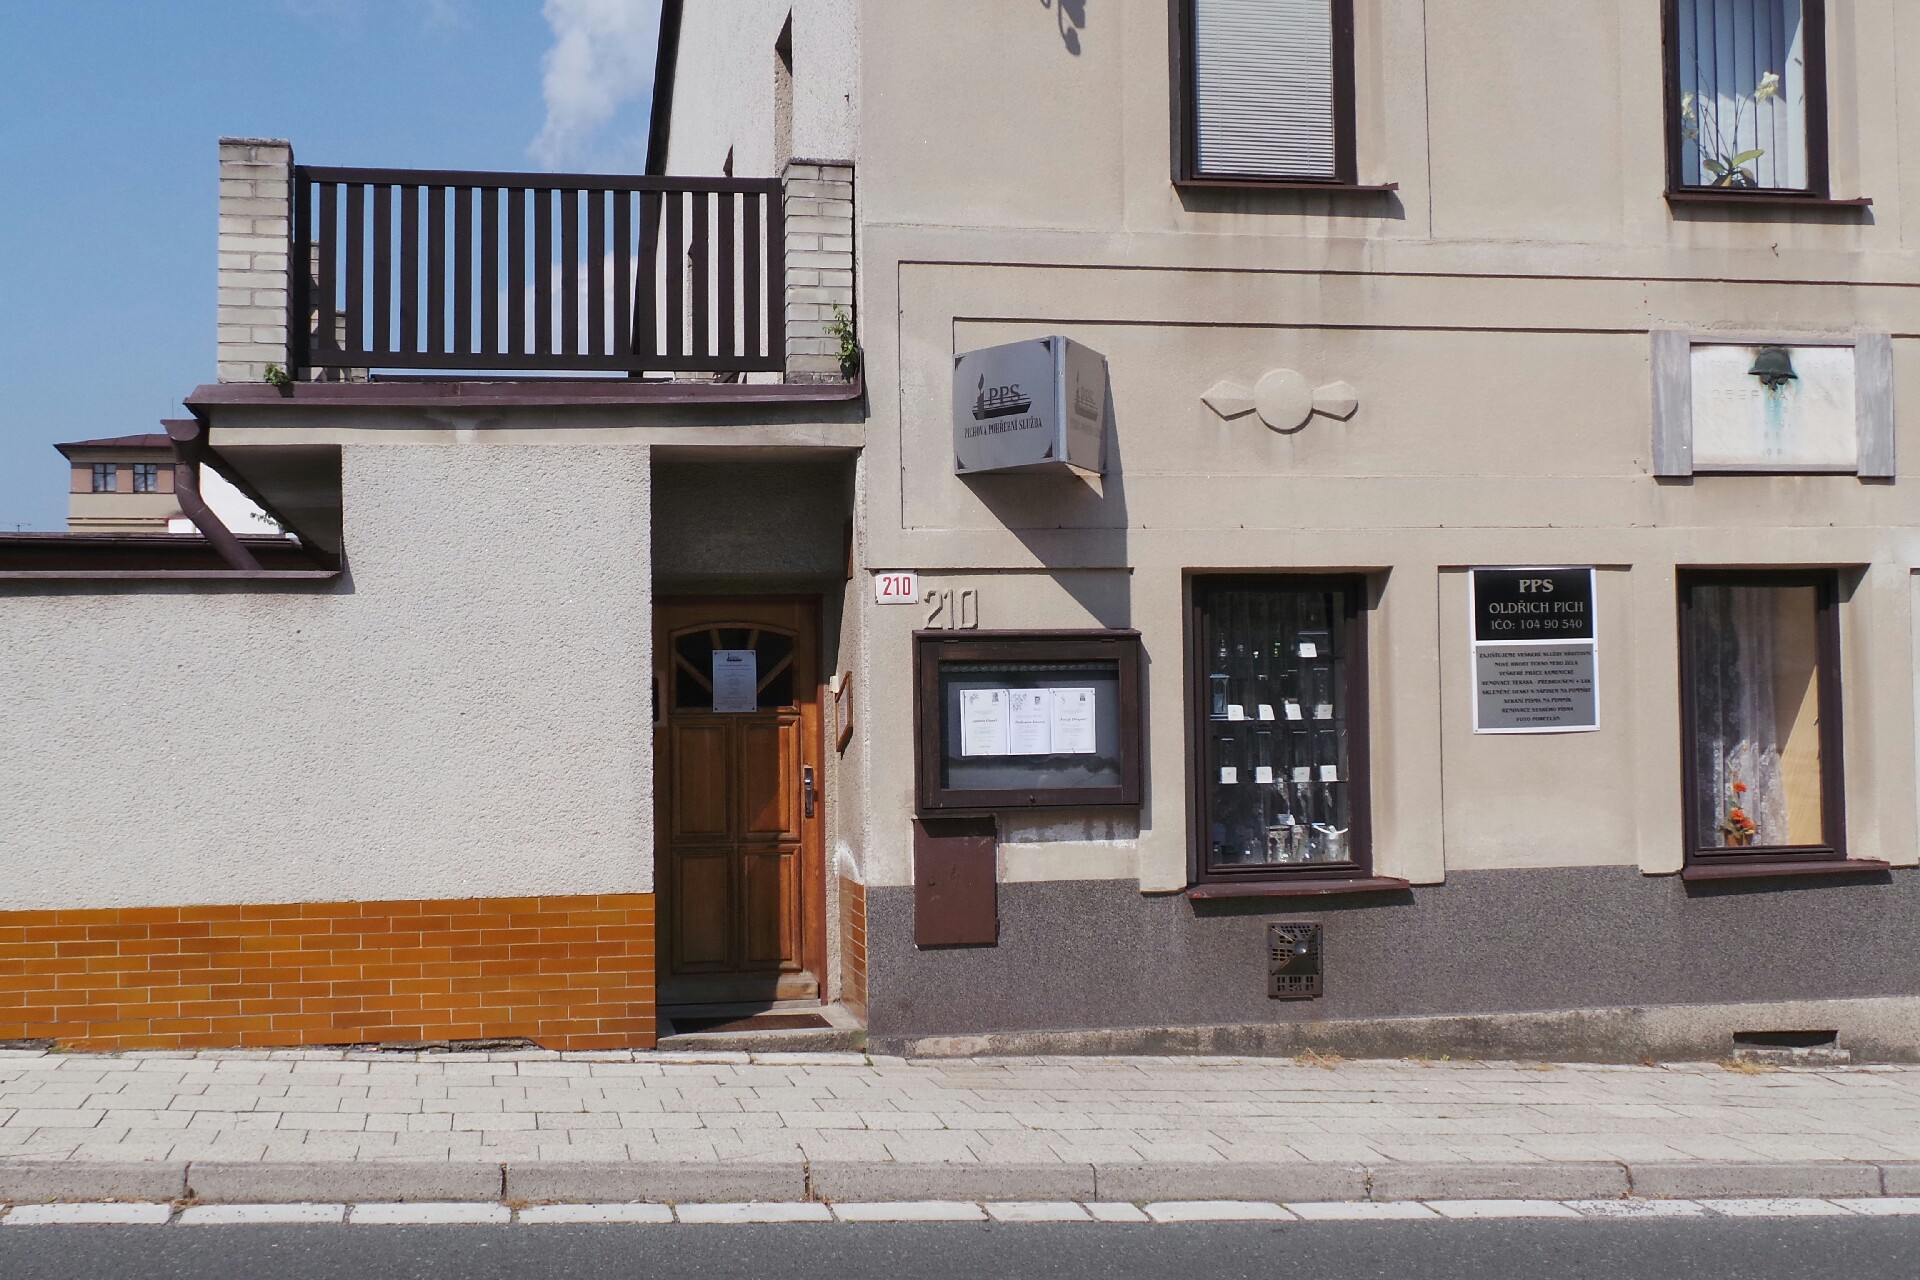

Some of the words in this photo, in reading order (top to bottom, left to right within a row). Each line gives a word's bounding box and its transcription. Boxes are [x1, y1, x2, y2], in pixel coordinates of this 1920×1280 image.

[989, 384, 1020, 404] PPS
[988, 417, 1018, 434] POHŘEBNÍ
[1018, 416, 1043, 429] SLUŽBA
[883, 577, 911, 595] 210
[1520, 579, 1554, 592] PPS
[924, 589, 978, 630] 210
[1489, 601, 1548, 613] OLDŘICH
[1554, 602, 1583, 612] PICH
[1491, 619, 1515, 629] IČO:
[1521, 620, 1540, 629] 104
[1544, 620, 1558, 628] 90
[1562, 619, 1582, 628] 540
